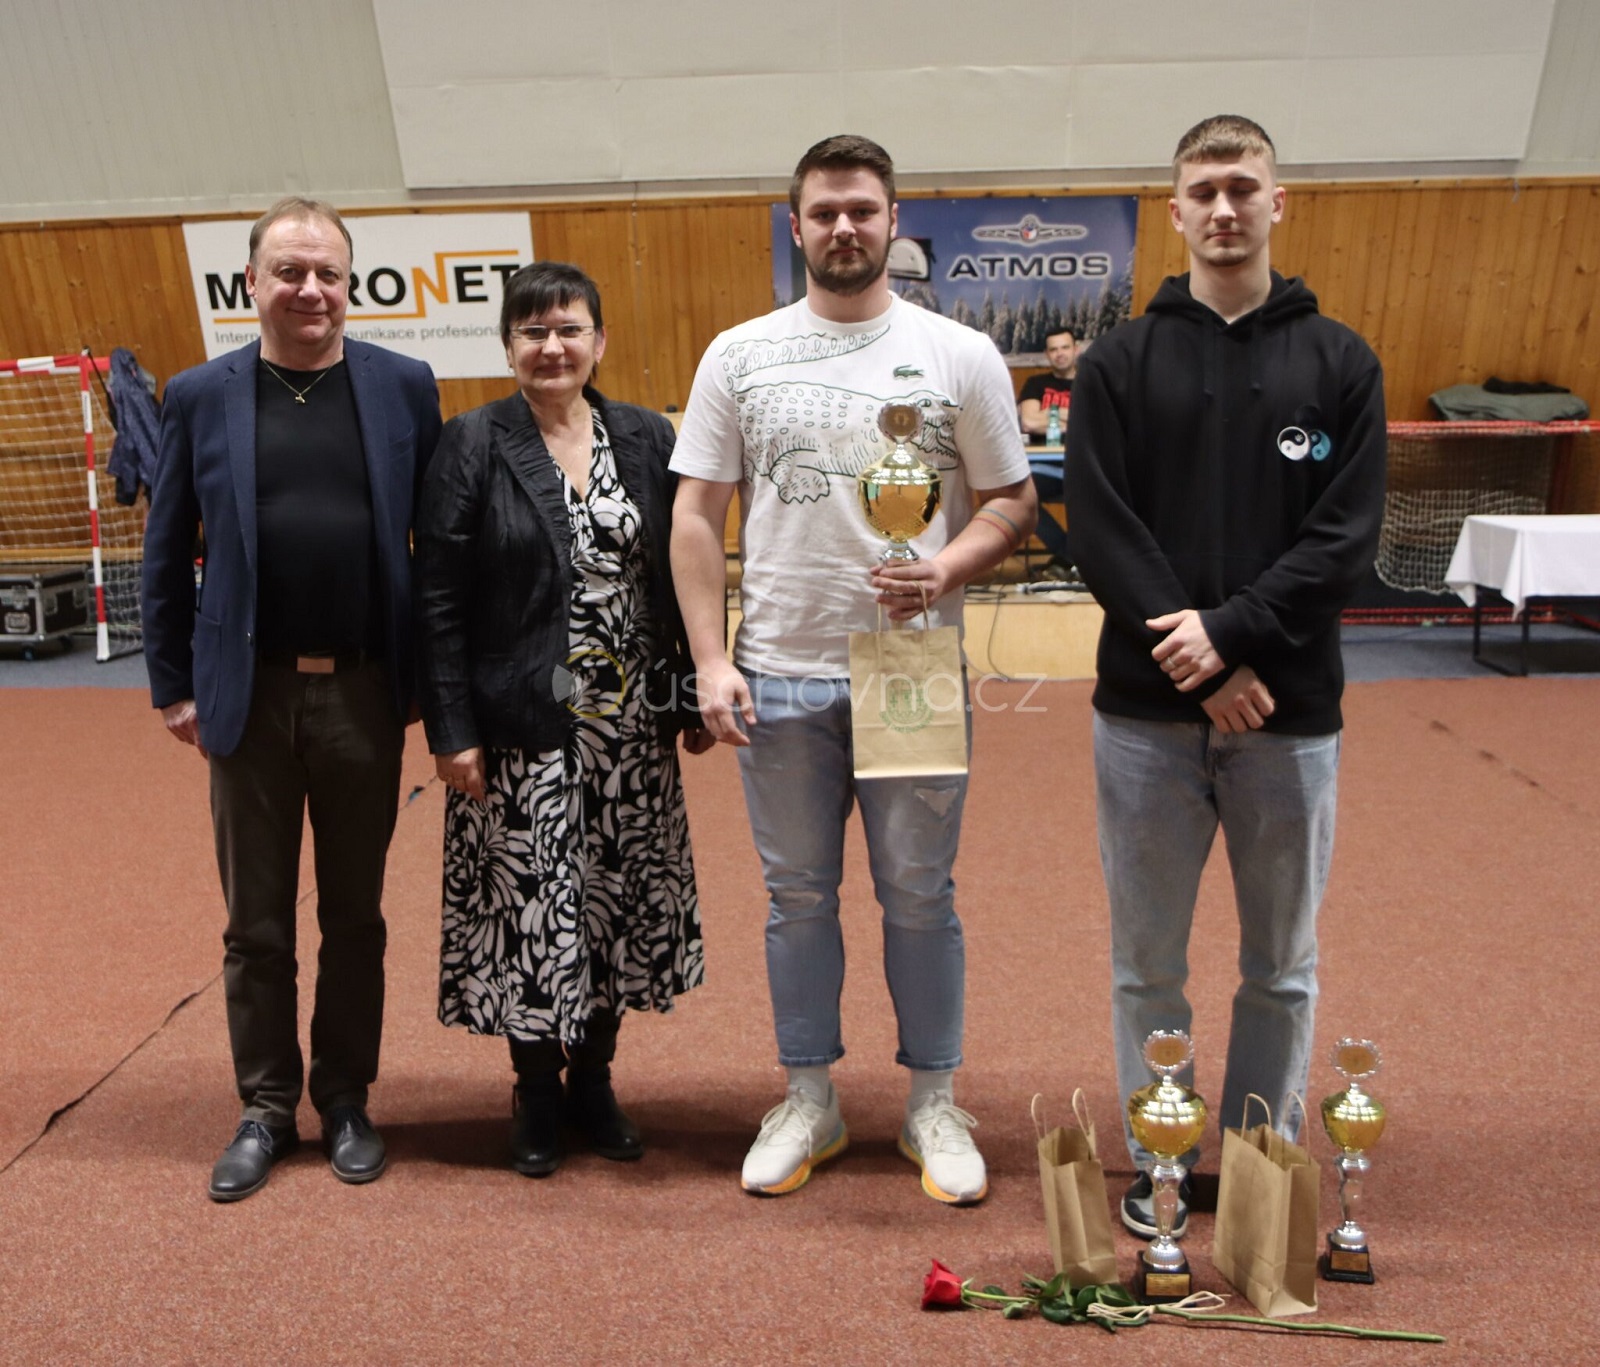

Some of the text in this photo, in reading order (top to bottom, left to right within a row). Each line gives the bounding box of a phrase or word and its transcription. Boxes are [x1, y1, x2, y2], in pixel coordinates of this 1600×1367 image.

[948, 254, 1110, 280] ATMOS
[214, 331, 259, 344] Intern
[420, 324, 501, 341] profesioná
